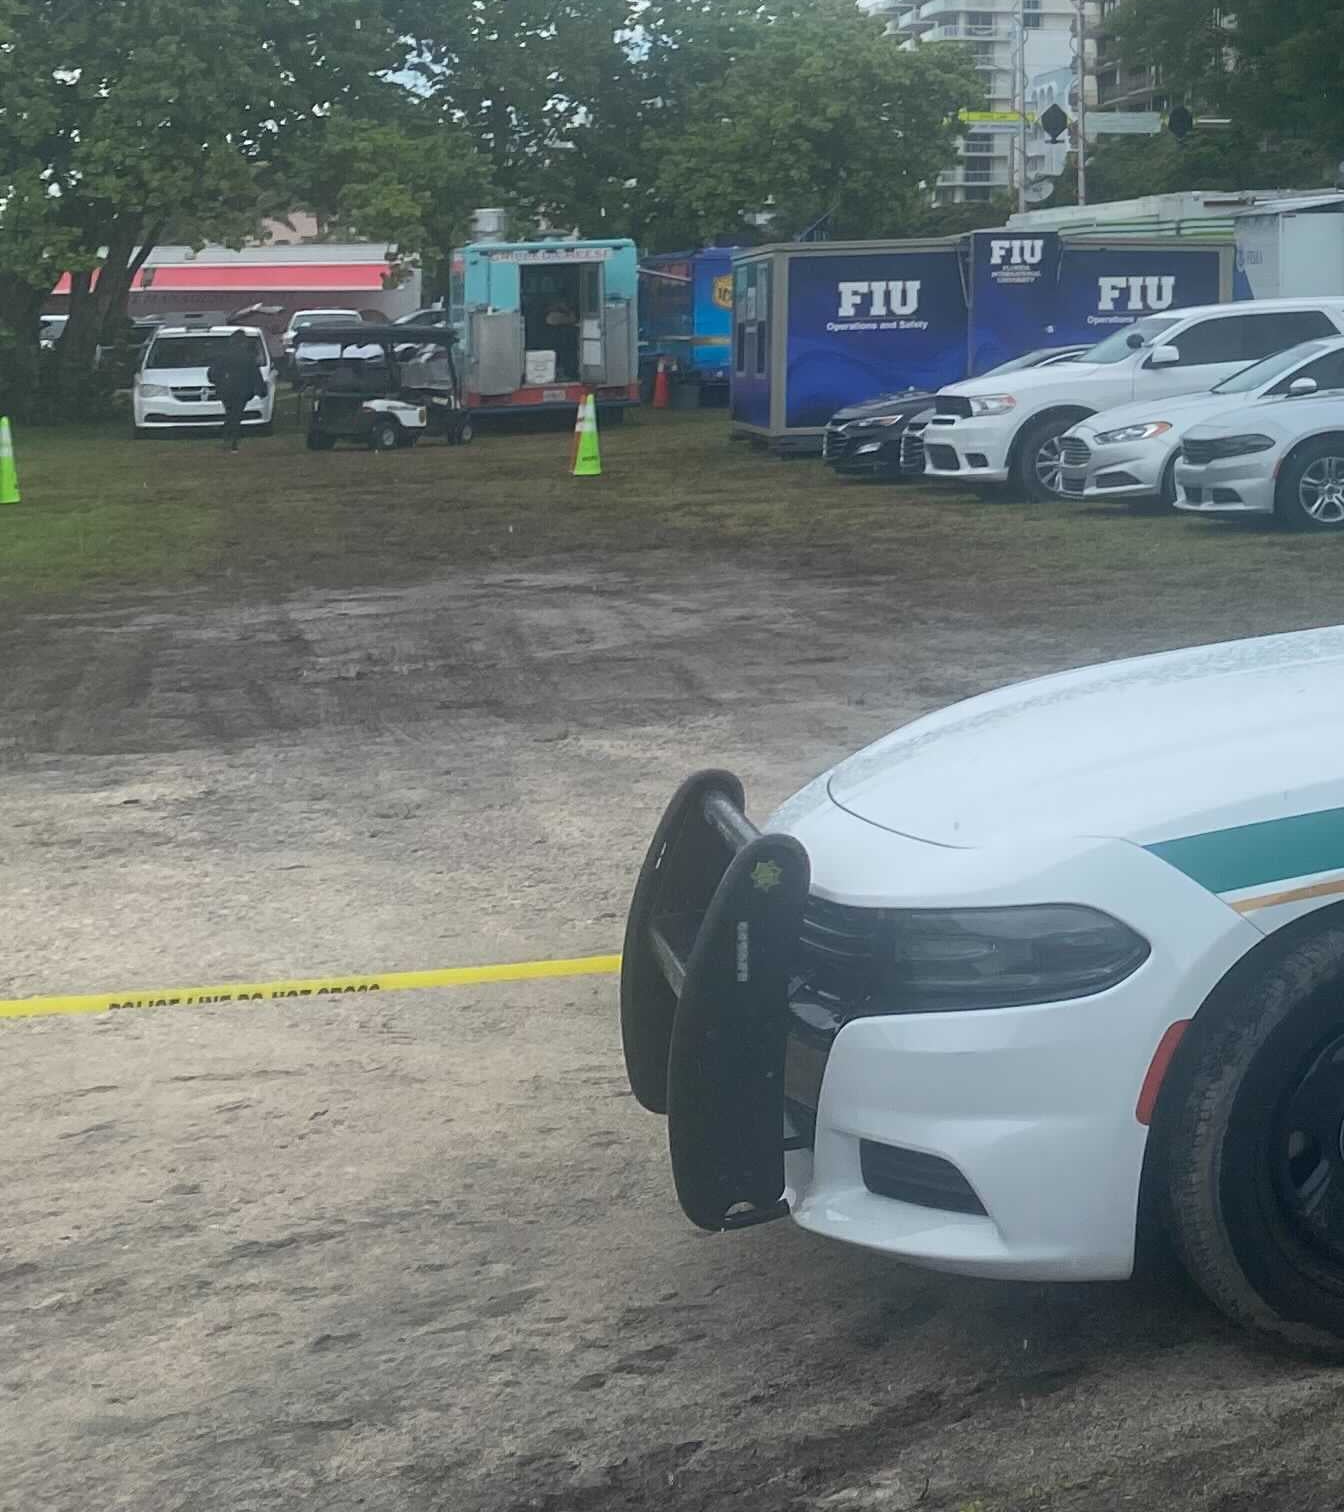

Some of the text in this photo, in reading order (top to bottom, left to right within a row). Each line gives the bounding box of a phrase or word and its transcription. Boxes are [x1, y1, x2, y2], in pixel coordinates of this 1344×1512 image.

[991, 239, 1044, 265] FIU
[838, 280, 920, 317] FIU
[1098, 276, 1175, 311] FIU
[826, 320, 929, 332] Operations and Safety
